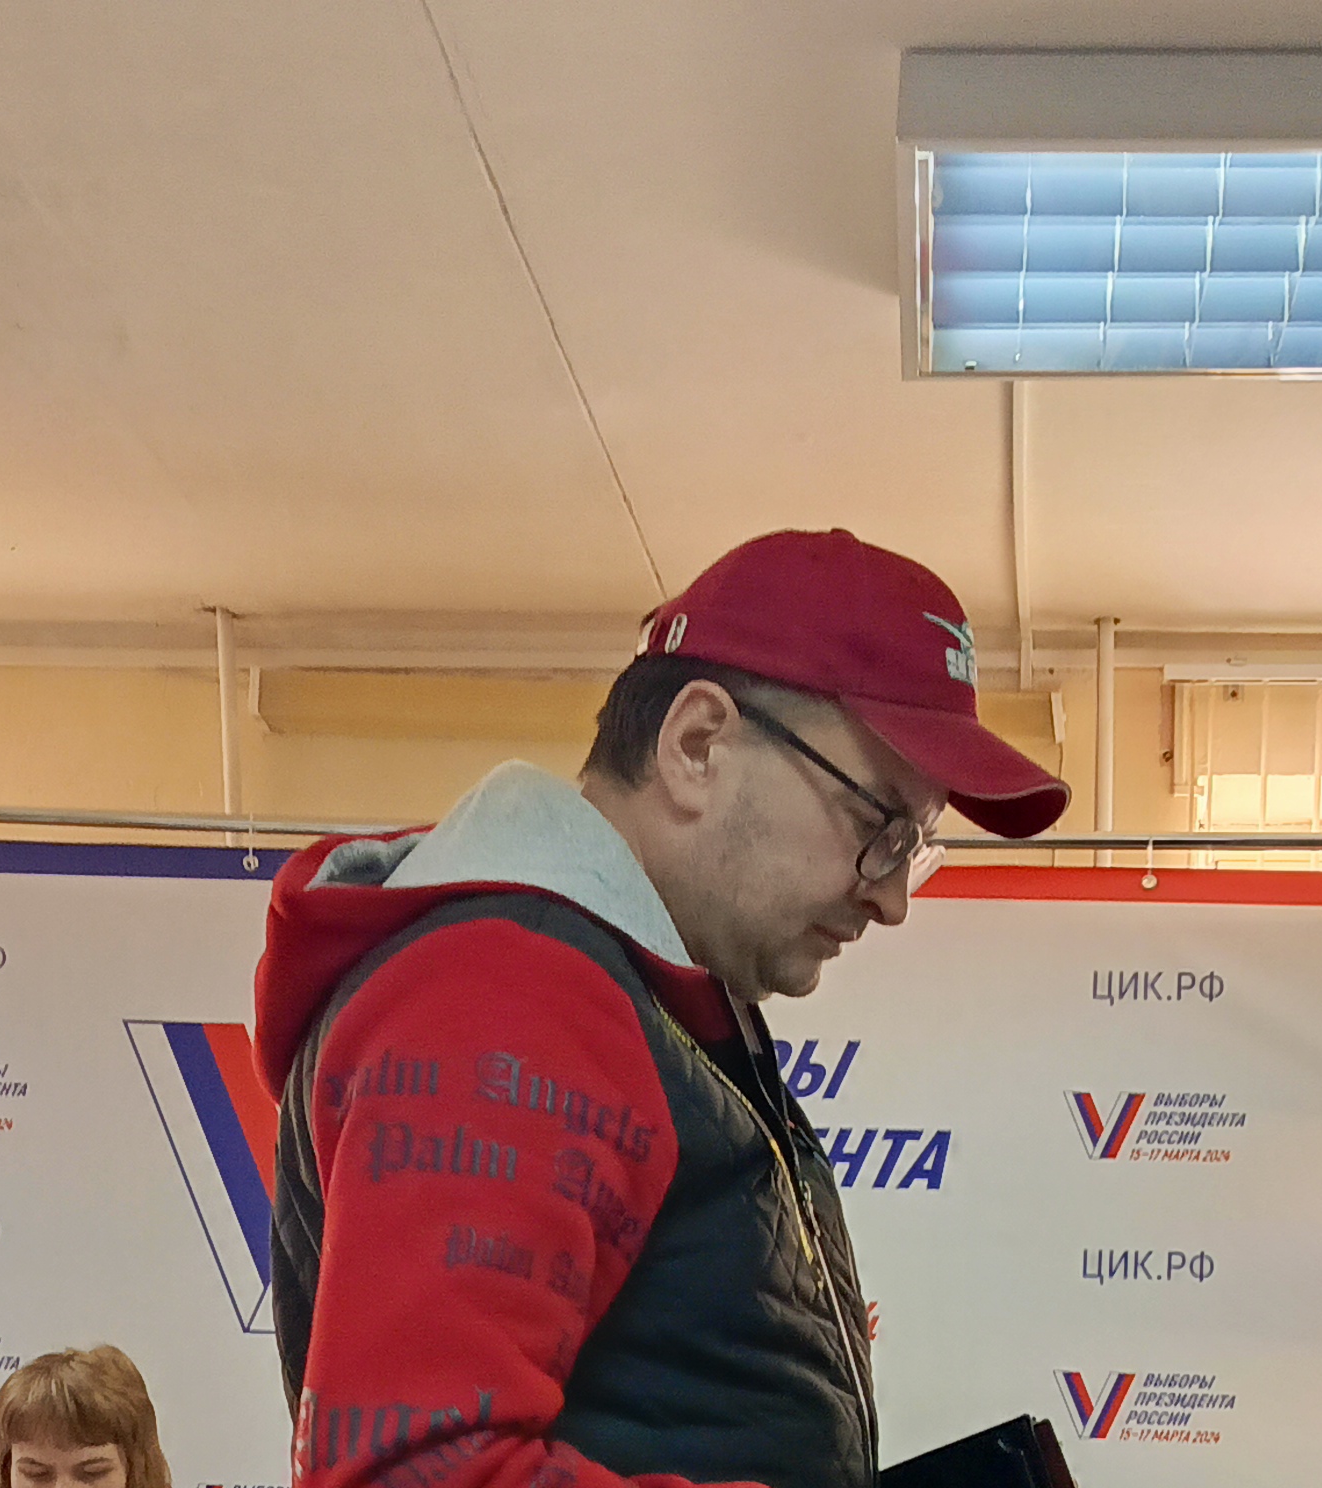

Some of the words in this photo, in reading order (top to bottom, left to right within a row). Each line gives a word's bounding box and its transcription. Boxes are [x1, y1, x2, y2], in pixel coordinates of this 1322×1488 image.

[1092, 970, 1224, 1006] ЦИК.РФ
[478, 1051, 658, 1164] Angels
[1153, 1092, 1226, 1108] ВЫБОРЫ
[1144, 1110, 1246, 1128] ПРЕЗИДЕНТА
[1135, 1129, 1202, 1145] РОССИИ
[367, 1121, 518, 1183] Palm
[1162, 1149, 1202, 1162] МАРТА
[1202, 1150, 1231, 1163] 2024
[1082, 1249, 1215, 1286] ЦИК.РФ
[1143, 1374, 1216, 1390] ВЫБОРЫ
[1134, 1392, 1236, 1410] ПРЕЗИДЕНТА
[1125, 1411, 1192, 1427] РОССИИ
[1152, 1430, 1191, 1444] МАРТА
[1192, 1431, 1221, 1445] 2024
